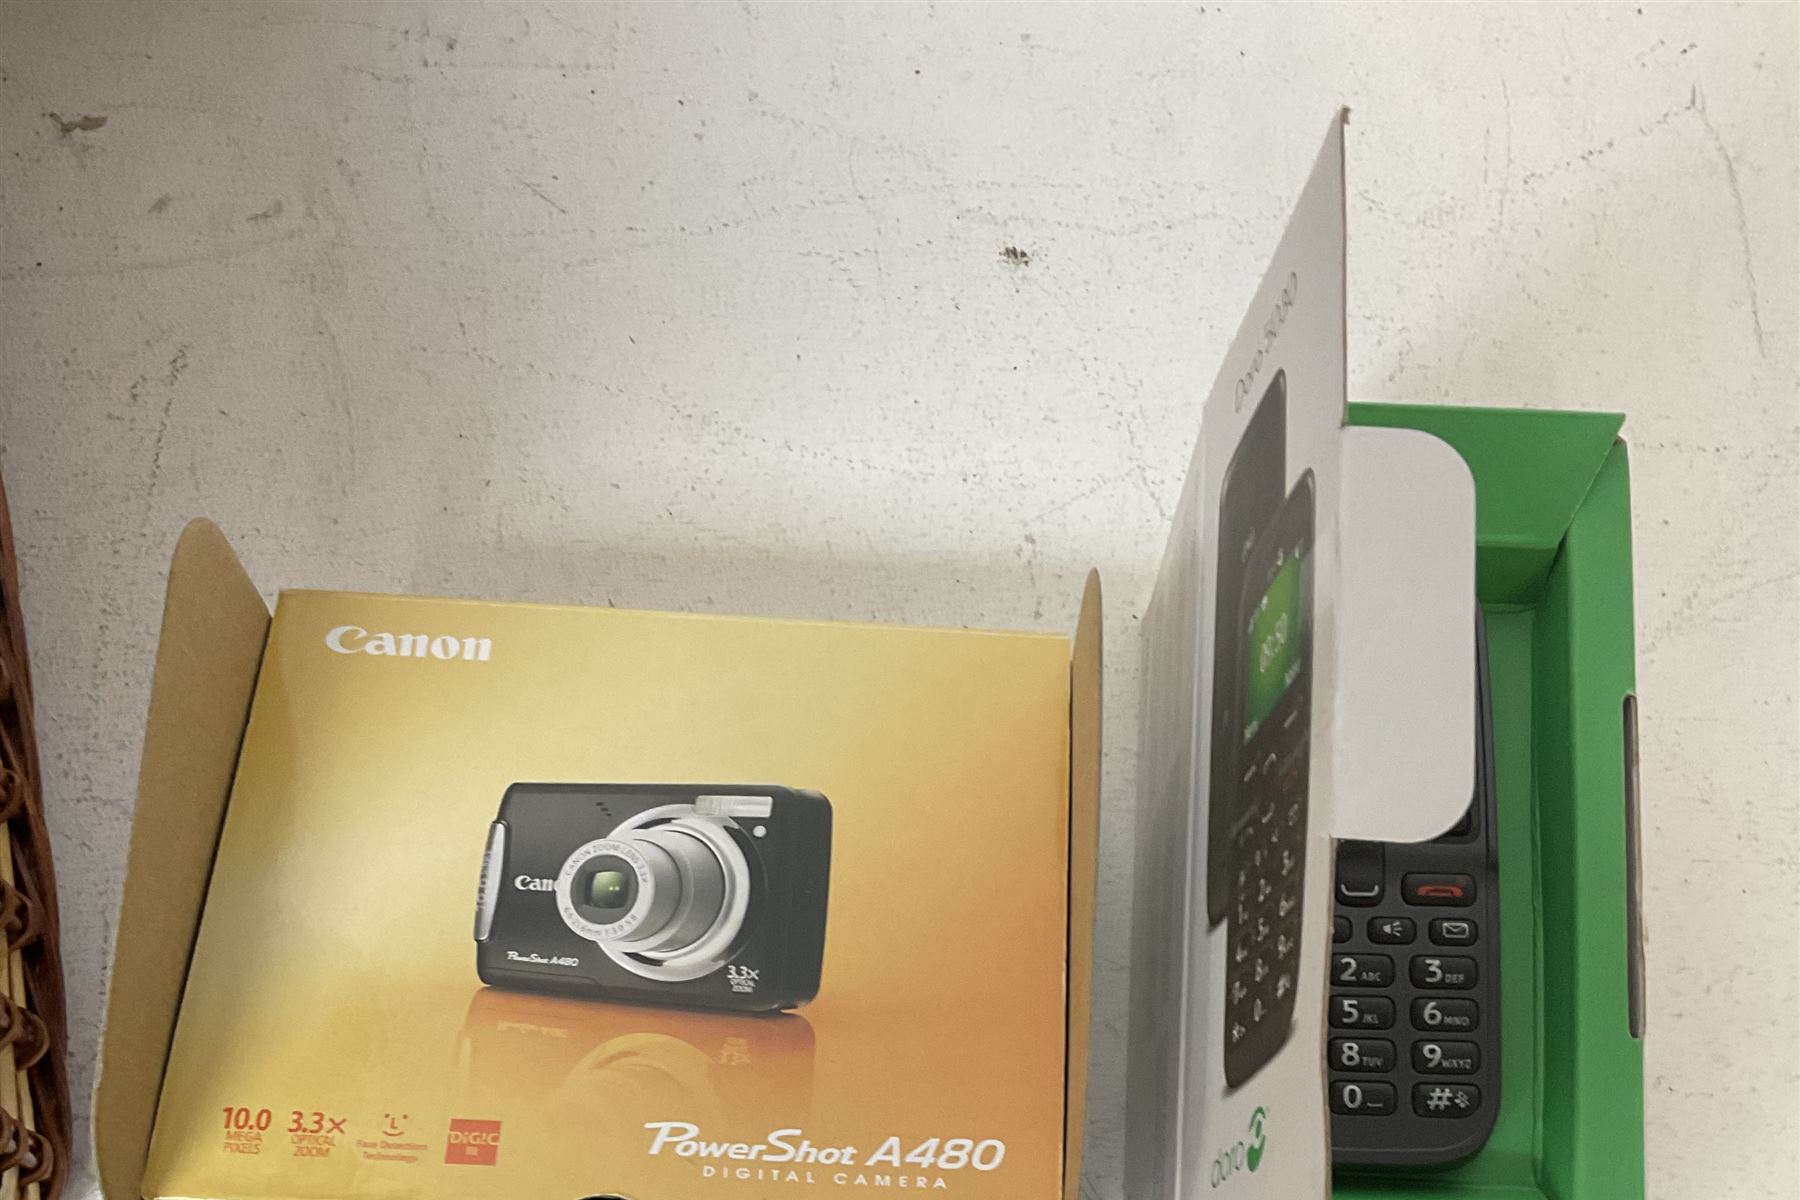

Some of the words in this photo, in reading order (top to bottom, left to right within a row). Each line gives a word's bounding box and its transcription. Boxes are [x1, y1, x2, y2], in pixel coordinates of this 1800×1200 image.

[325, 625, 492, 661] Canon
[1339, 957, 1358, 982] 2
[1360, 971, 1382, 982] ABC
[1424, 959, 1443, 983] 3
[1341, 999, 1359, 1023] 5
[1423, 1001, 1442, 1025] 6
[1341, 1042, 1360, 1067] 8
[1422, 1044, 1442, 1068] 9
[1342, 1084, 1363, 1109] 0
[223, 1106, 272, 1131] 10.0
[225, 1130, 262, 1142] MEGA
[291, 1134, 336, 1147] OPTICAL
[644, 1121, 859, 1166] PowerShot
[865, 1136, 1006, 1171] A480
[293, 1145, 331, 1157] ZOOM
[702, 1165, 816, 1184] DIGITAL
[833, 1172, 948, 1190] CAMERA
